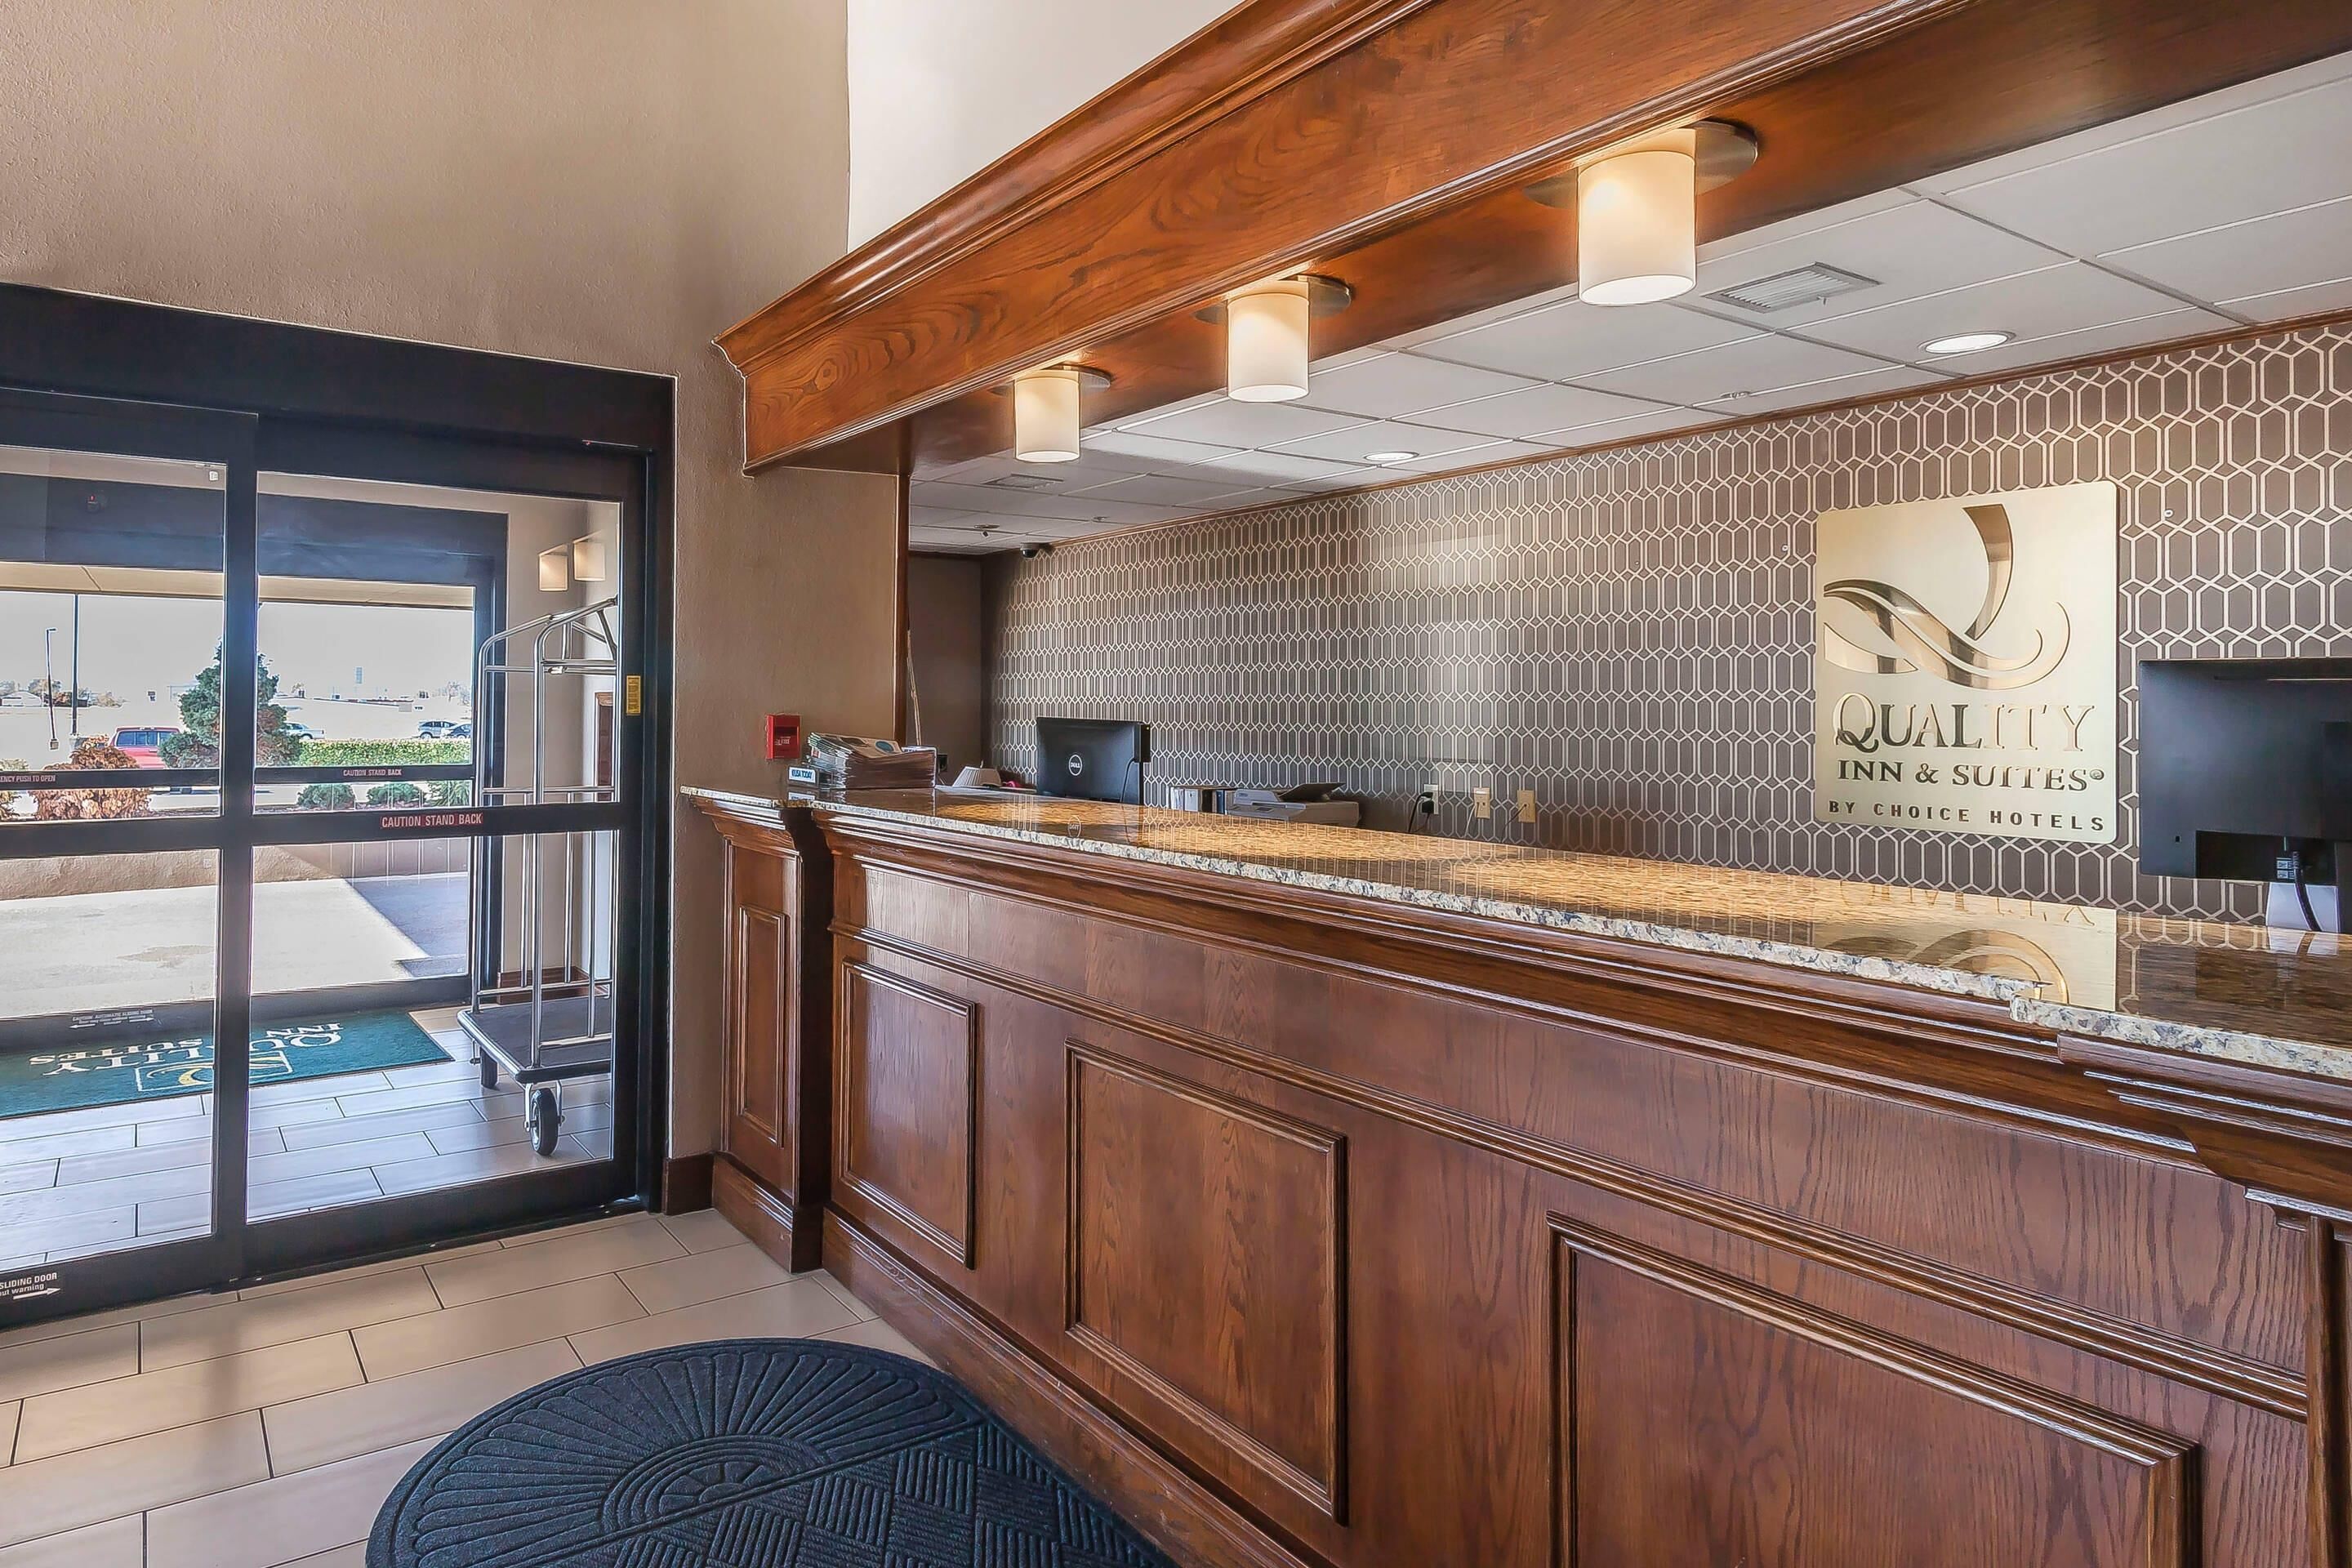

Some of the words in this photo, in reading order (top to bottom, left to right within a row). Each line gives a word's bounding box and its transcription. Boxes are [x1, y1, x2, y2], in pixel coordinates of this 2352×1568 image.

[1833, 692, 2096, 754] QUALITY
[1838, 760, 1904, 783] INN
[1914, 763, 1940, 785] &
[381, 815, 421, 828] CAUTION
[425, 814, 455, 826] STAND
[458, 813, 482, 825] BACK
[1829, 800, 1856, 814] BY
[1873, 803, 1970, 822] CHOICE
[1989, 810, 2104, 831] HOTELS
[28, 1038, 203, 1066] SUITES
[11, 1283, 45, 1294] warning
[33, 1272, 58, 1283] DOOR
